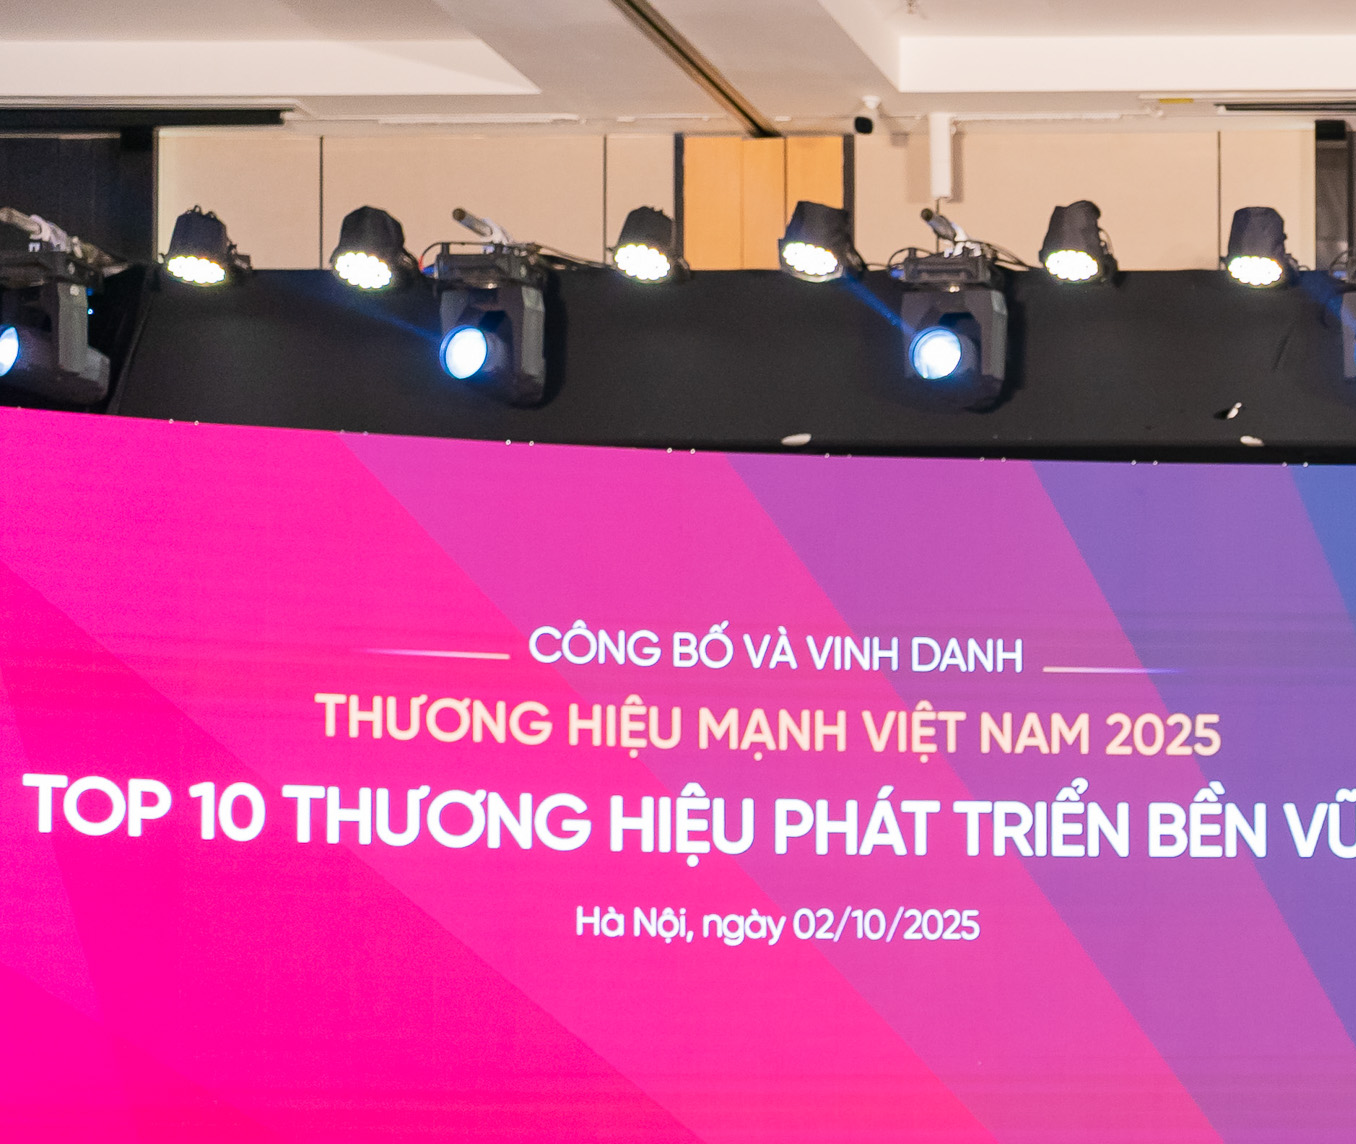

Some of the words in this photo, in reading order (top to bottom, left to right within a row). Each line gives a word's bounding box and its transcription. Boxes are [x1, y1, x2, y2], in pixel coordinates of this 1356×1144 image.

[528, 619, 662, 667] CÔNG
[672, 620, 734, 669] BỐ
[742, 625, 798, 670] VÀ
[805, 635, 899, 671] VINH
[911, 636, 1023, 673] DANH
[314, 693, 553, 745] THƯƠNG
[569, 694, 681, 758] HIỆU
[699, 707, 846, 761] MẠNH
[861, 700, 967, 763] VIỆT
[980, 711, 1089, 755] NAM
[1105, 712, 1221, 756] 2025
[22, 773, 172, 837] TOP
[188, 781, 266, 842] 10
[281, 784, 592, 851] THƯƠNG
[610, 782, 755, 868] HIỆU
[774, 784, 941, 856] PHÁT
[952, 777, 1130, 858] TRIỂN
[1148, 780, 1267, 858] BỀN
[576, 905, 625, 938] Hà
[633, 906, 694, 944] Nội,
[702, 908, 787, 947] ngày
[792, 906, 981, 942] 02/10/2025
